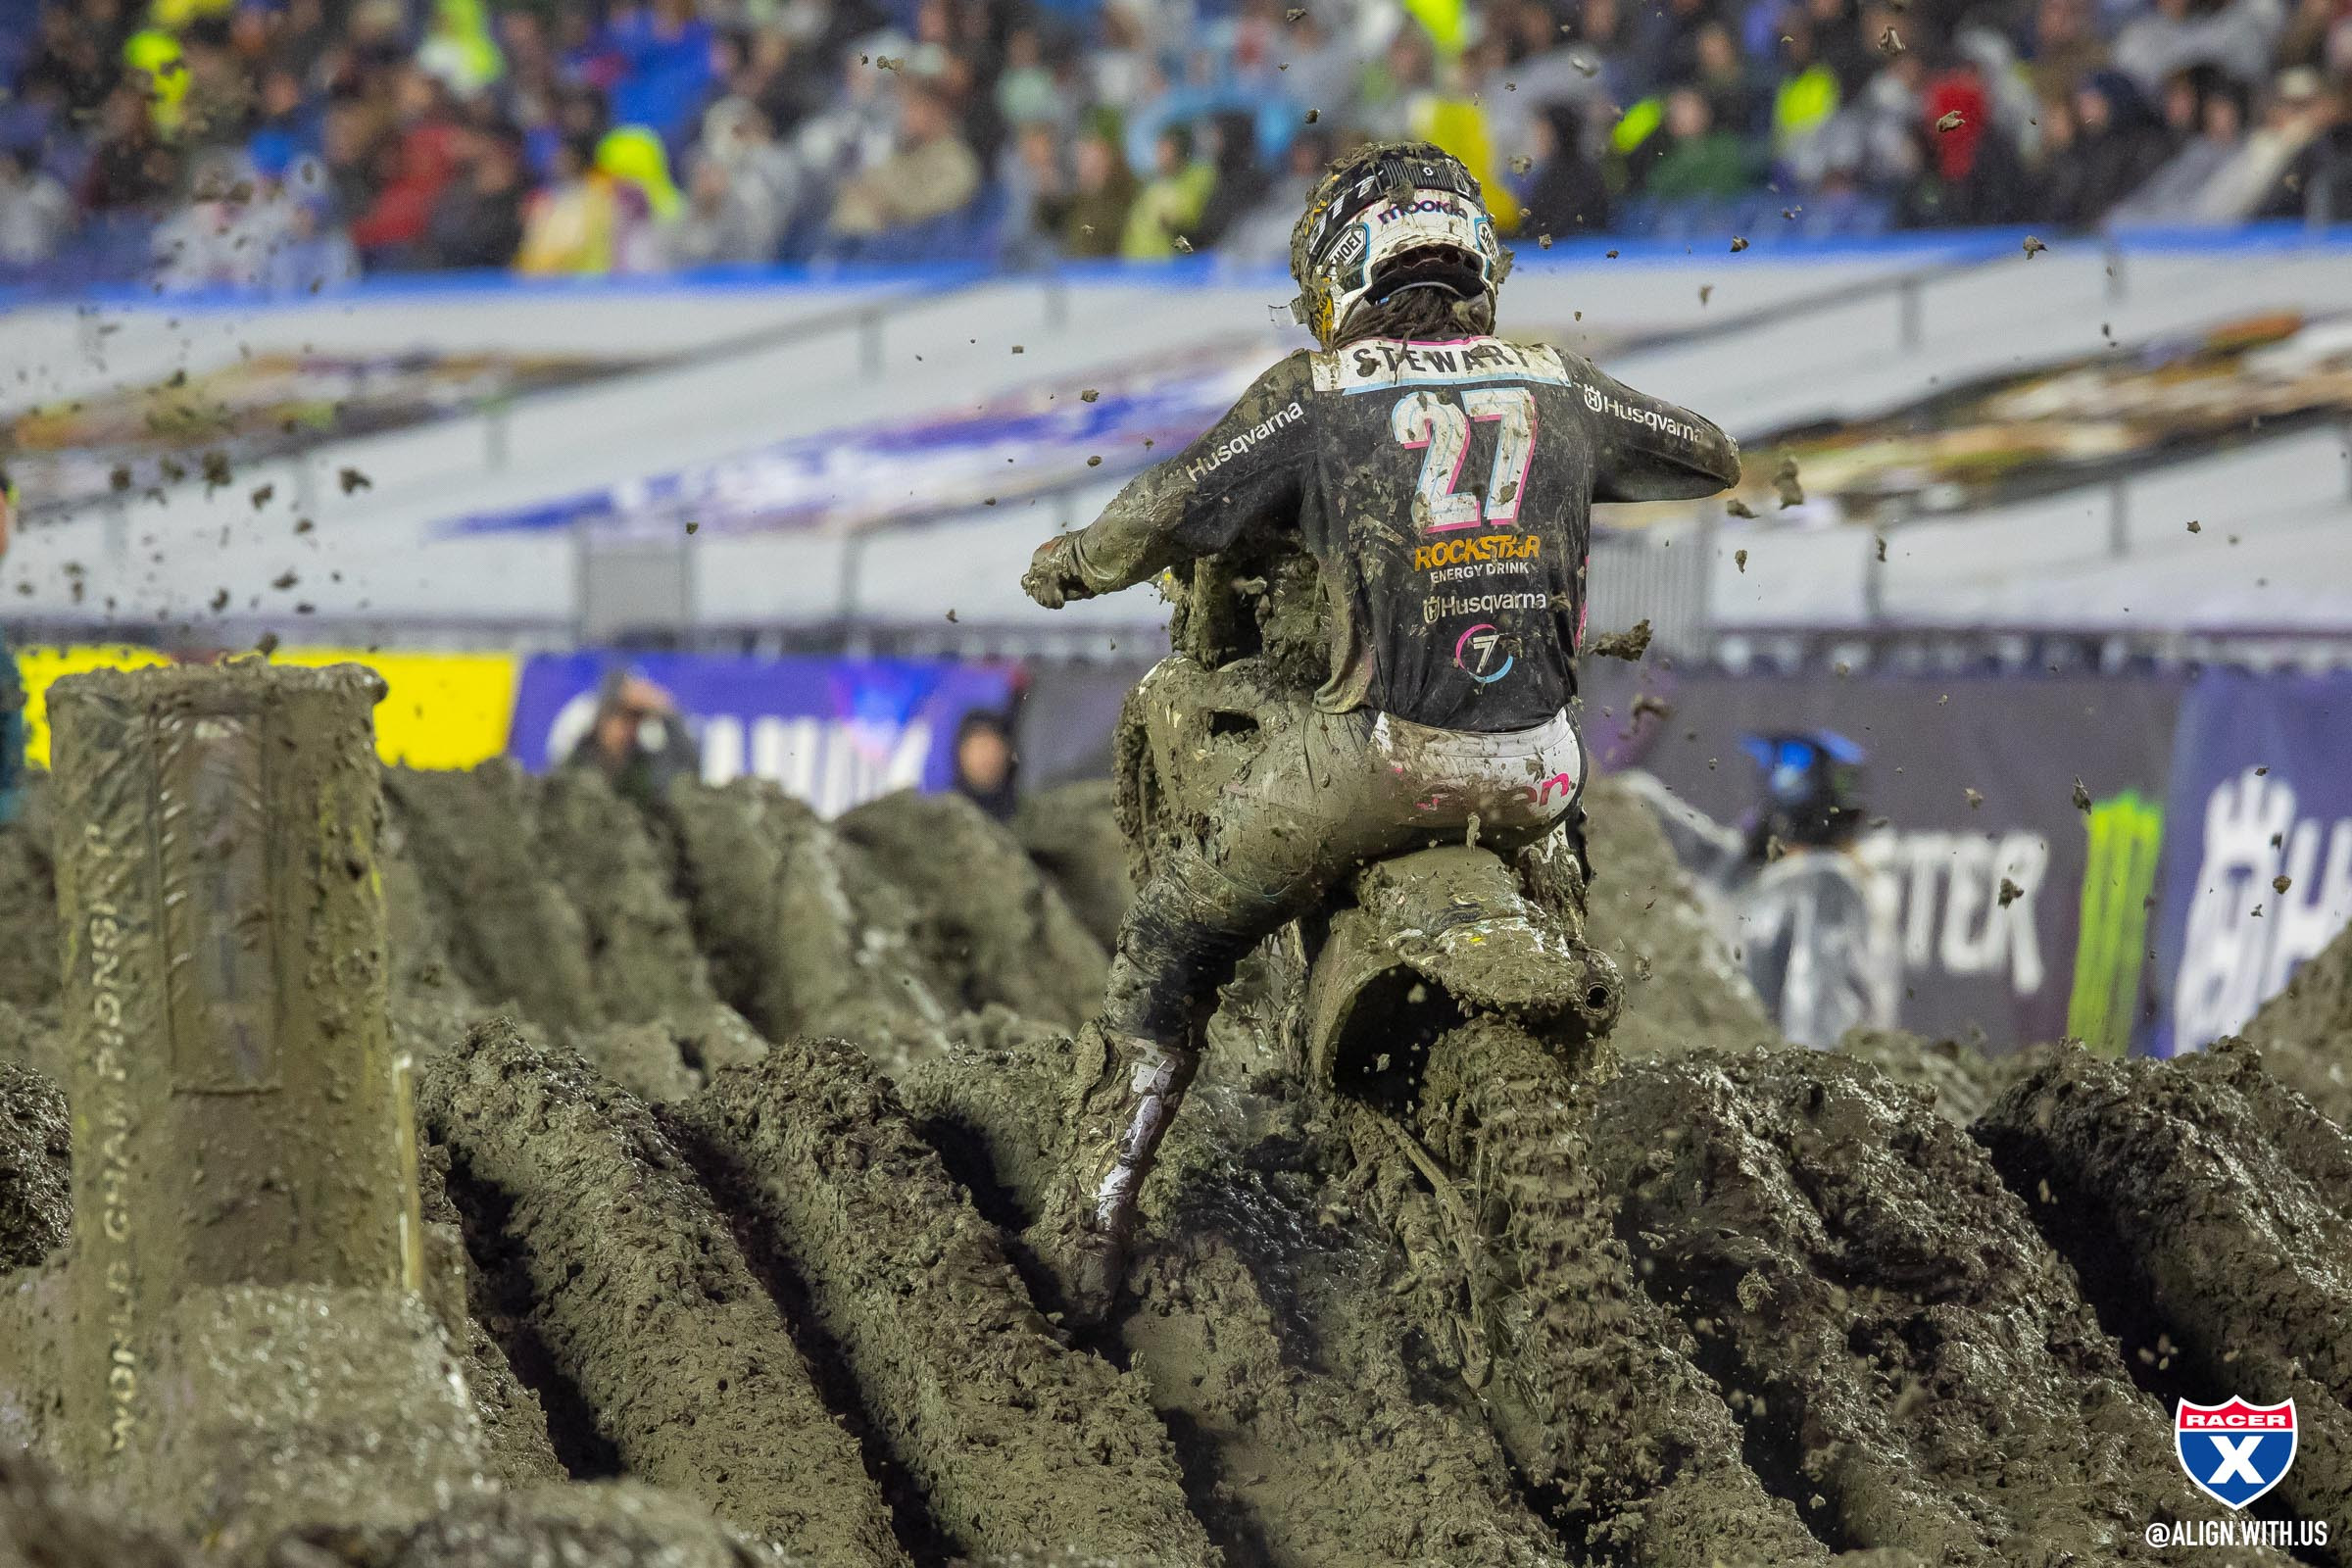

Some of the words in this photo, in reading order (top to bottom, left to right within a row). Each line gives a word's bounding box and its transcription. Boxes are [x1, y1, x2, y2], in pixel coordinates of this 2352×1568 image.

[1352, 345, 1530, 378] STEWART
[1603, 395, 1703, 442] Husqvarna
[1185, 402, 1304, 482] Husqvarna
[1392, 387, 1538, 533] 27
[1430, 564, 1484, 584] ENERGY
[1486, 562, 1530, 576] DRINK
[1442, 593, 1546, 617] Husqvarna
